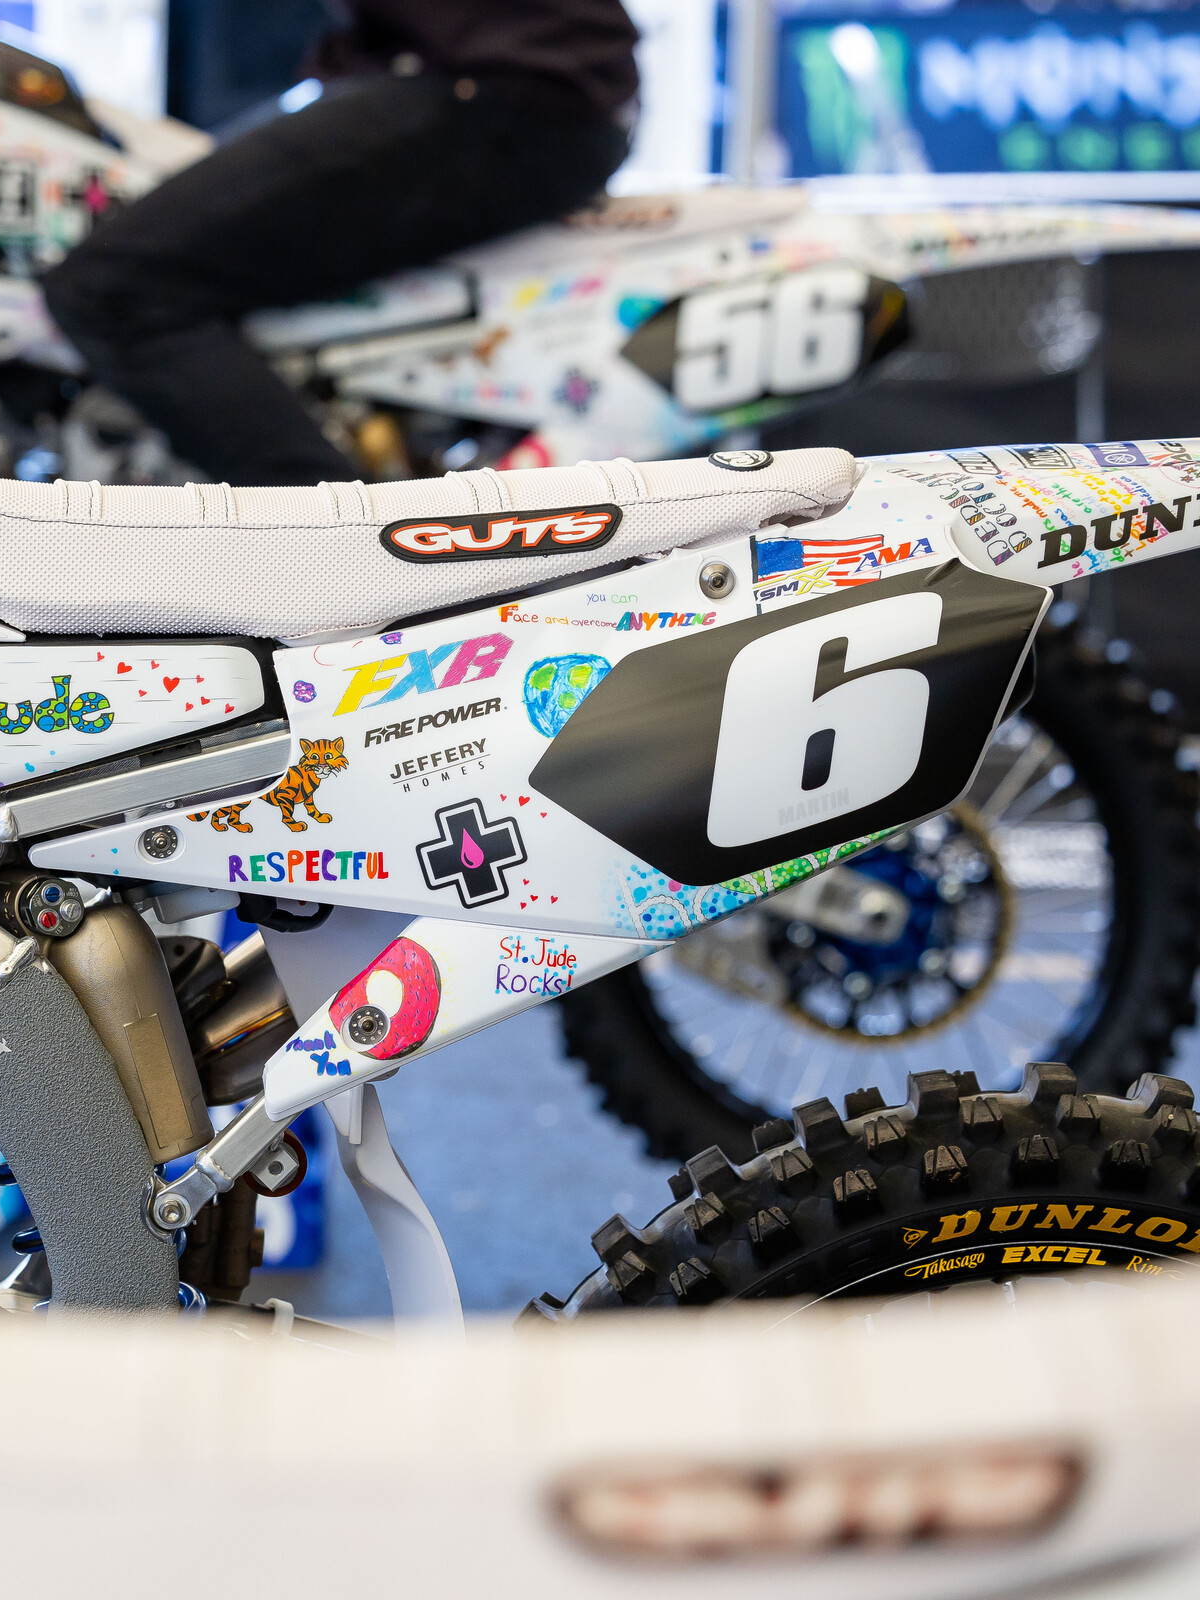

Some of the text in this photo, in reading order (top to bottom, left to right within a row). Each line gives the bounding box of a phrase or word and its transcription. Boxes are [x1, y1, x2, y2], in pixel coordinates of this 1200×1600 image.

[672, 267, 870, 412] 56
[391, 510, 613, 555] GUTS
[854, 537, 936, 573] AMA
[586, 592, 639, 606] you can
[759, 566, 834, 602] SMX
[500, 604, 717, 632] Face and overcome ANYTHING
[332, 632, 515, 717] FXR
[364, 697, 502, 748] FIRE POWER
[707, 591, 943, 848] 6
[389, 737, 487, 780] JEFFERY
[403, 761, 485, 793] HOMES
[778, 788, 849, 826] MARTIN
[228, 849, 389, 883] RESPECTFUL
[310, 1051, 352, 1076] You
[904, 1245, 1168, 1279] Takasago EXCEL Rim
